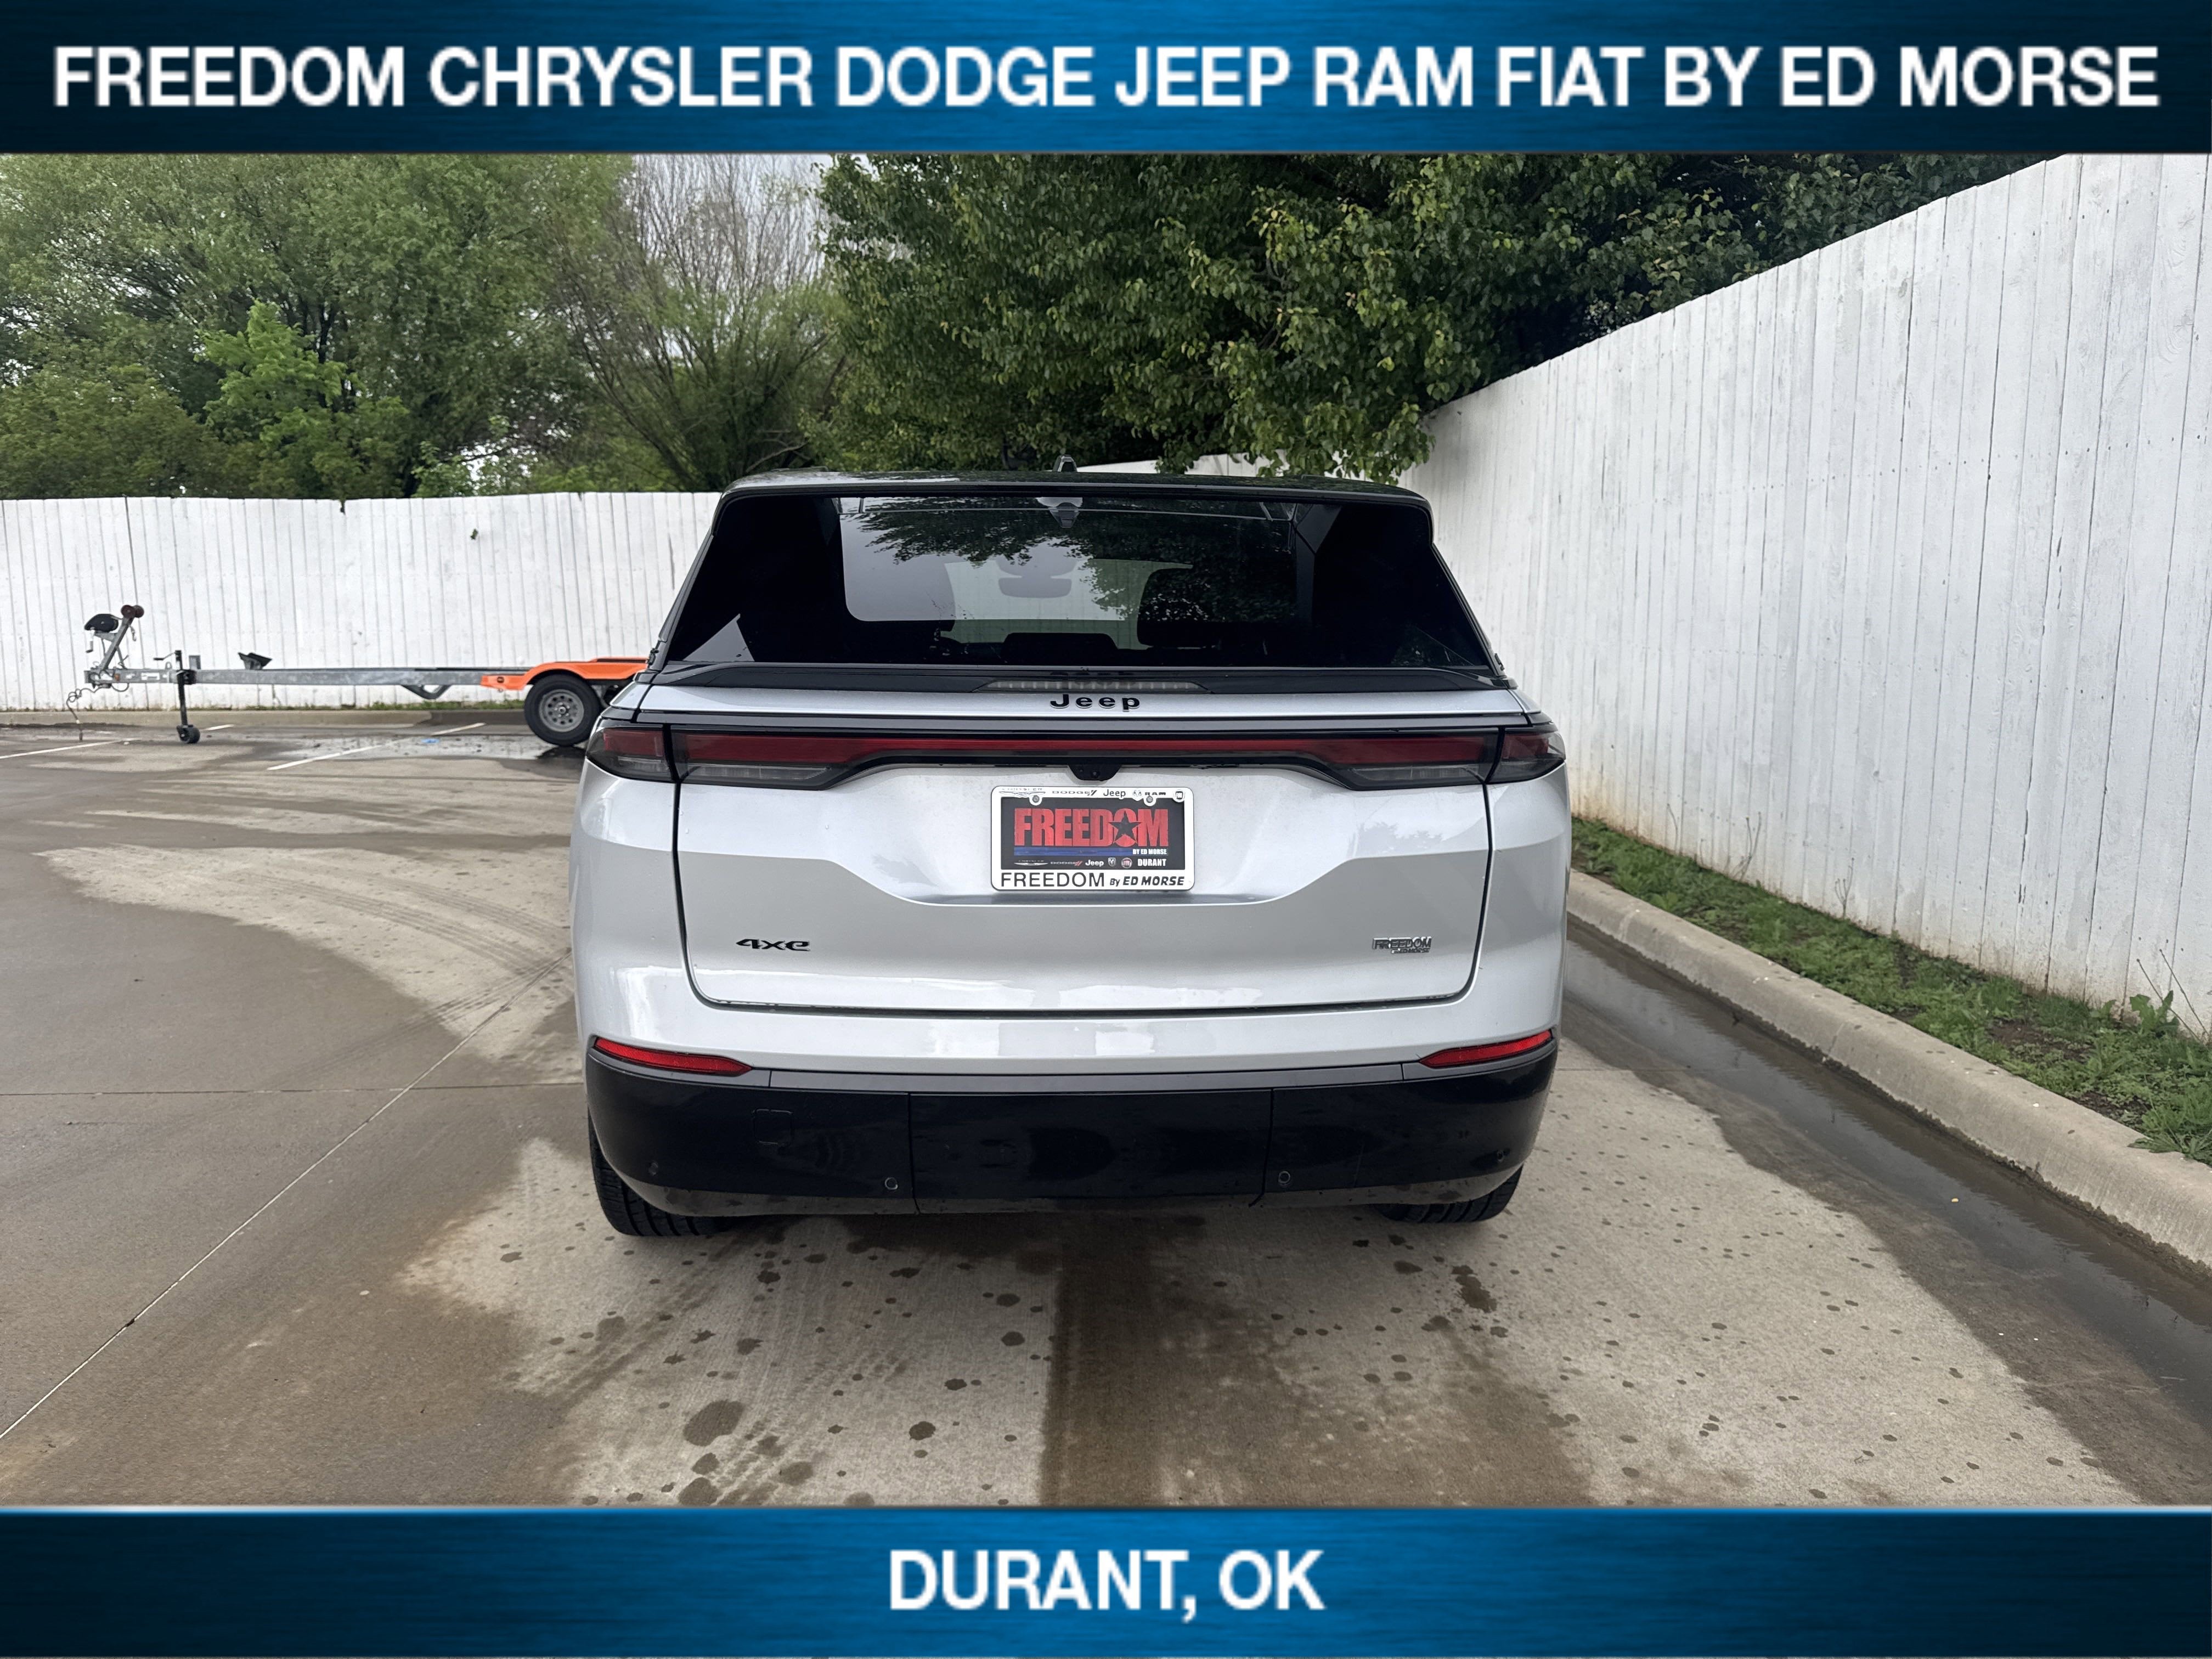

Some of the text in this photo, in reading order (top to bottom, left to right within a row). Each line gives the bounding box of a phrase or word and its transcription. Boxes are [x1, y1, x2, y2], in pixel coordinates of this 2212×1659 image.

[1050, 693, 1140, 712] Jeep
[1103, 789, 1126, 798] Jeep
[1014, 808, 1169, 847] FREEDOM
[1001, 872, 1185, 887] FREEDOM By ED MORSE
[1373, 936, 1432, 950] FREEDOM
